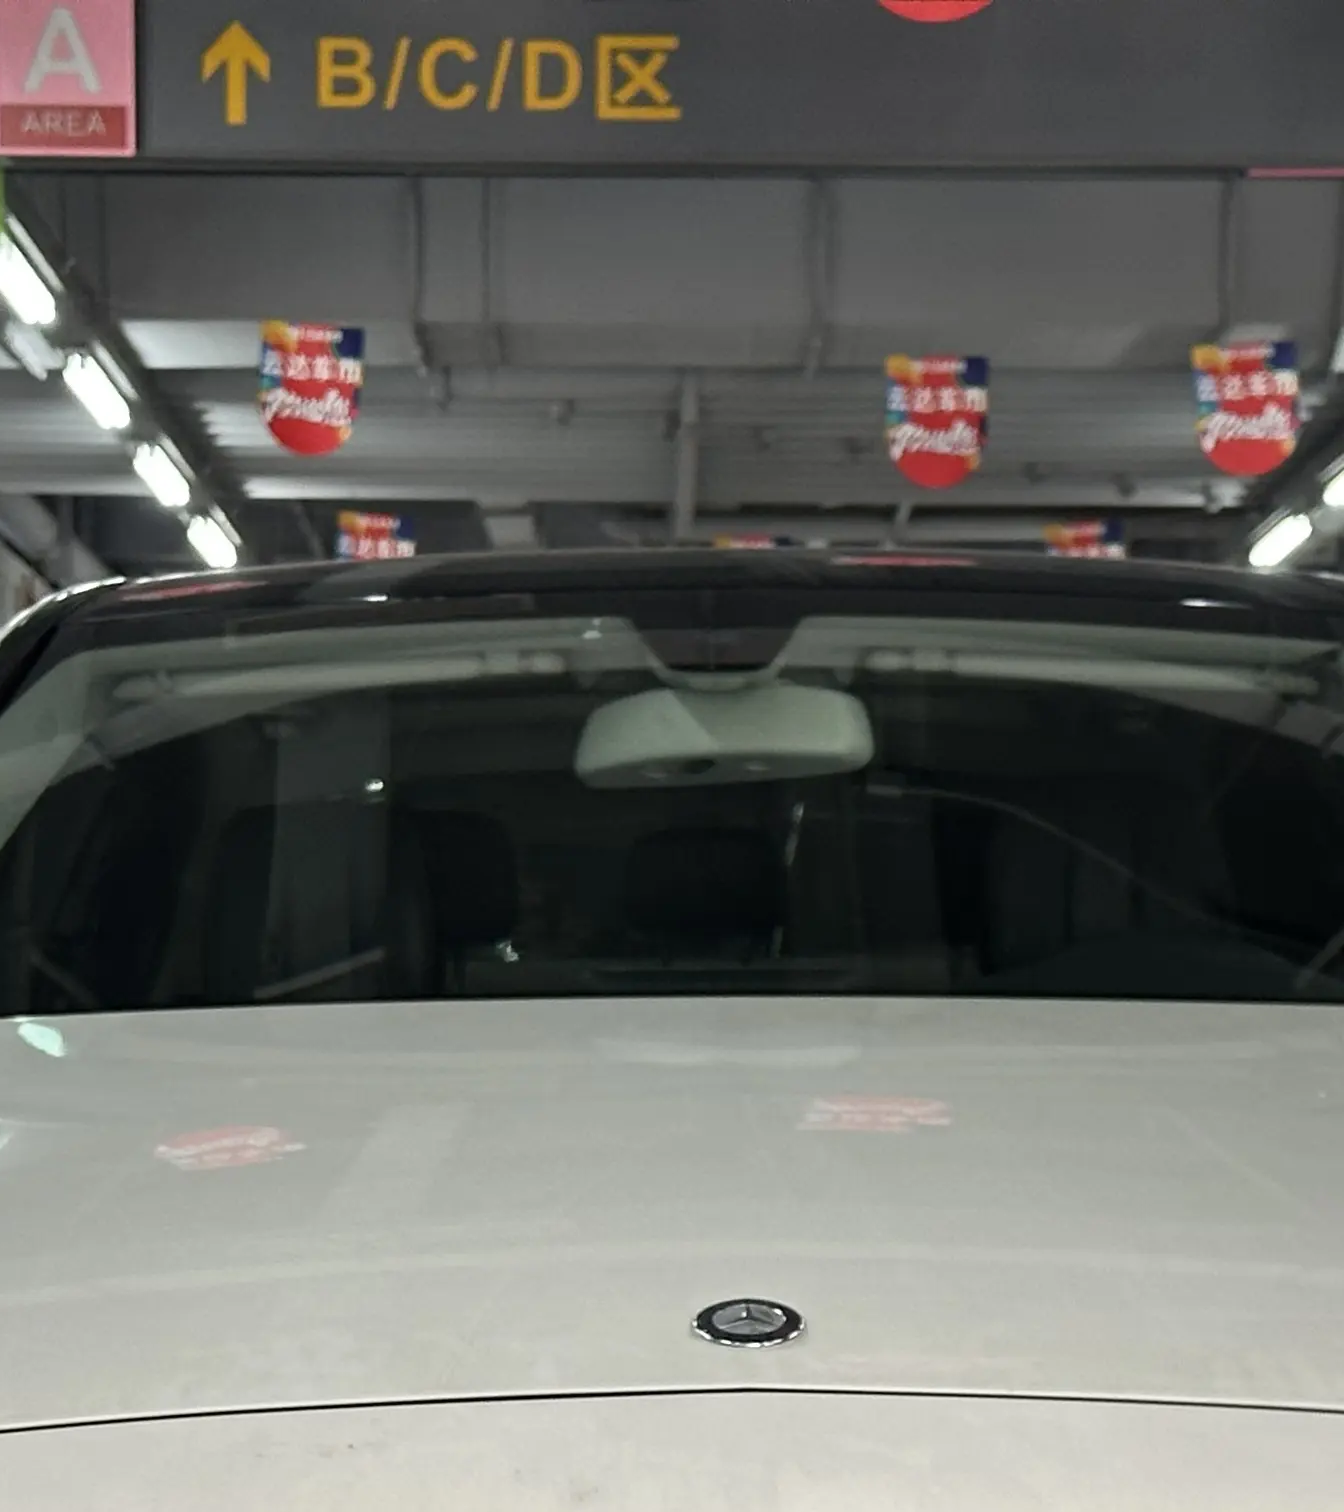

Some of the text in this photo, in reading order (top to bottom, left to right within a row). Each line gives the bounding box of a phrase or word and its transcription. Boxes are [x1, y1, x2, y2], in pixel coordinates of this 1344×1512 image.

[22, 6, 103, 95] A
[316, 35, 682, 121] B/C/D区
[20, 109, 107, 137] AREA
